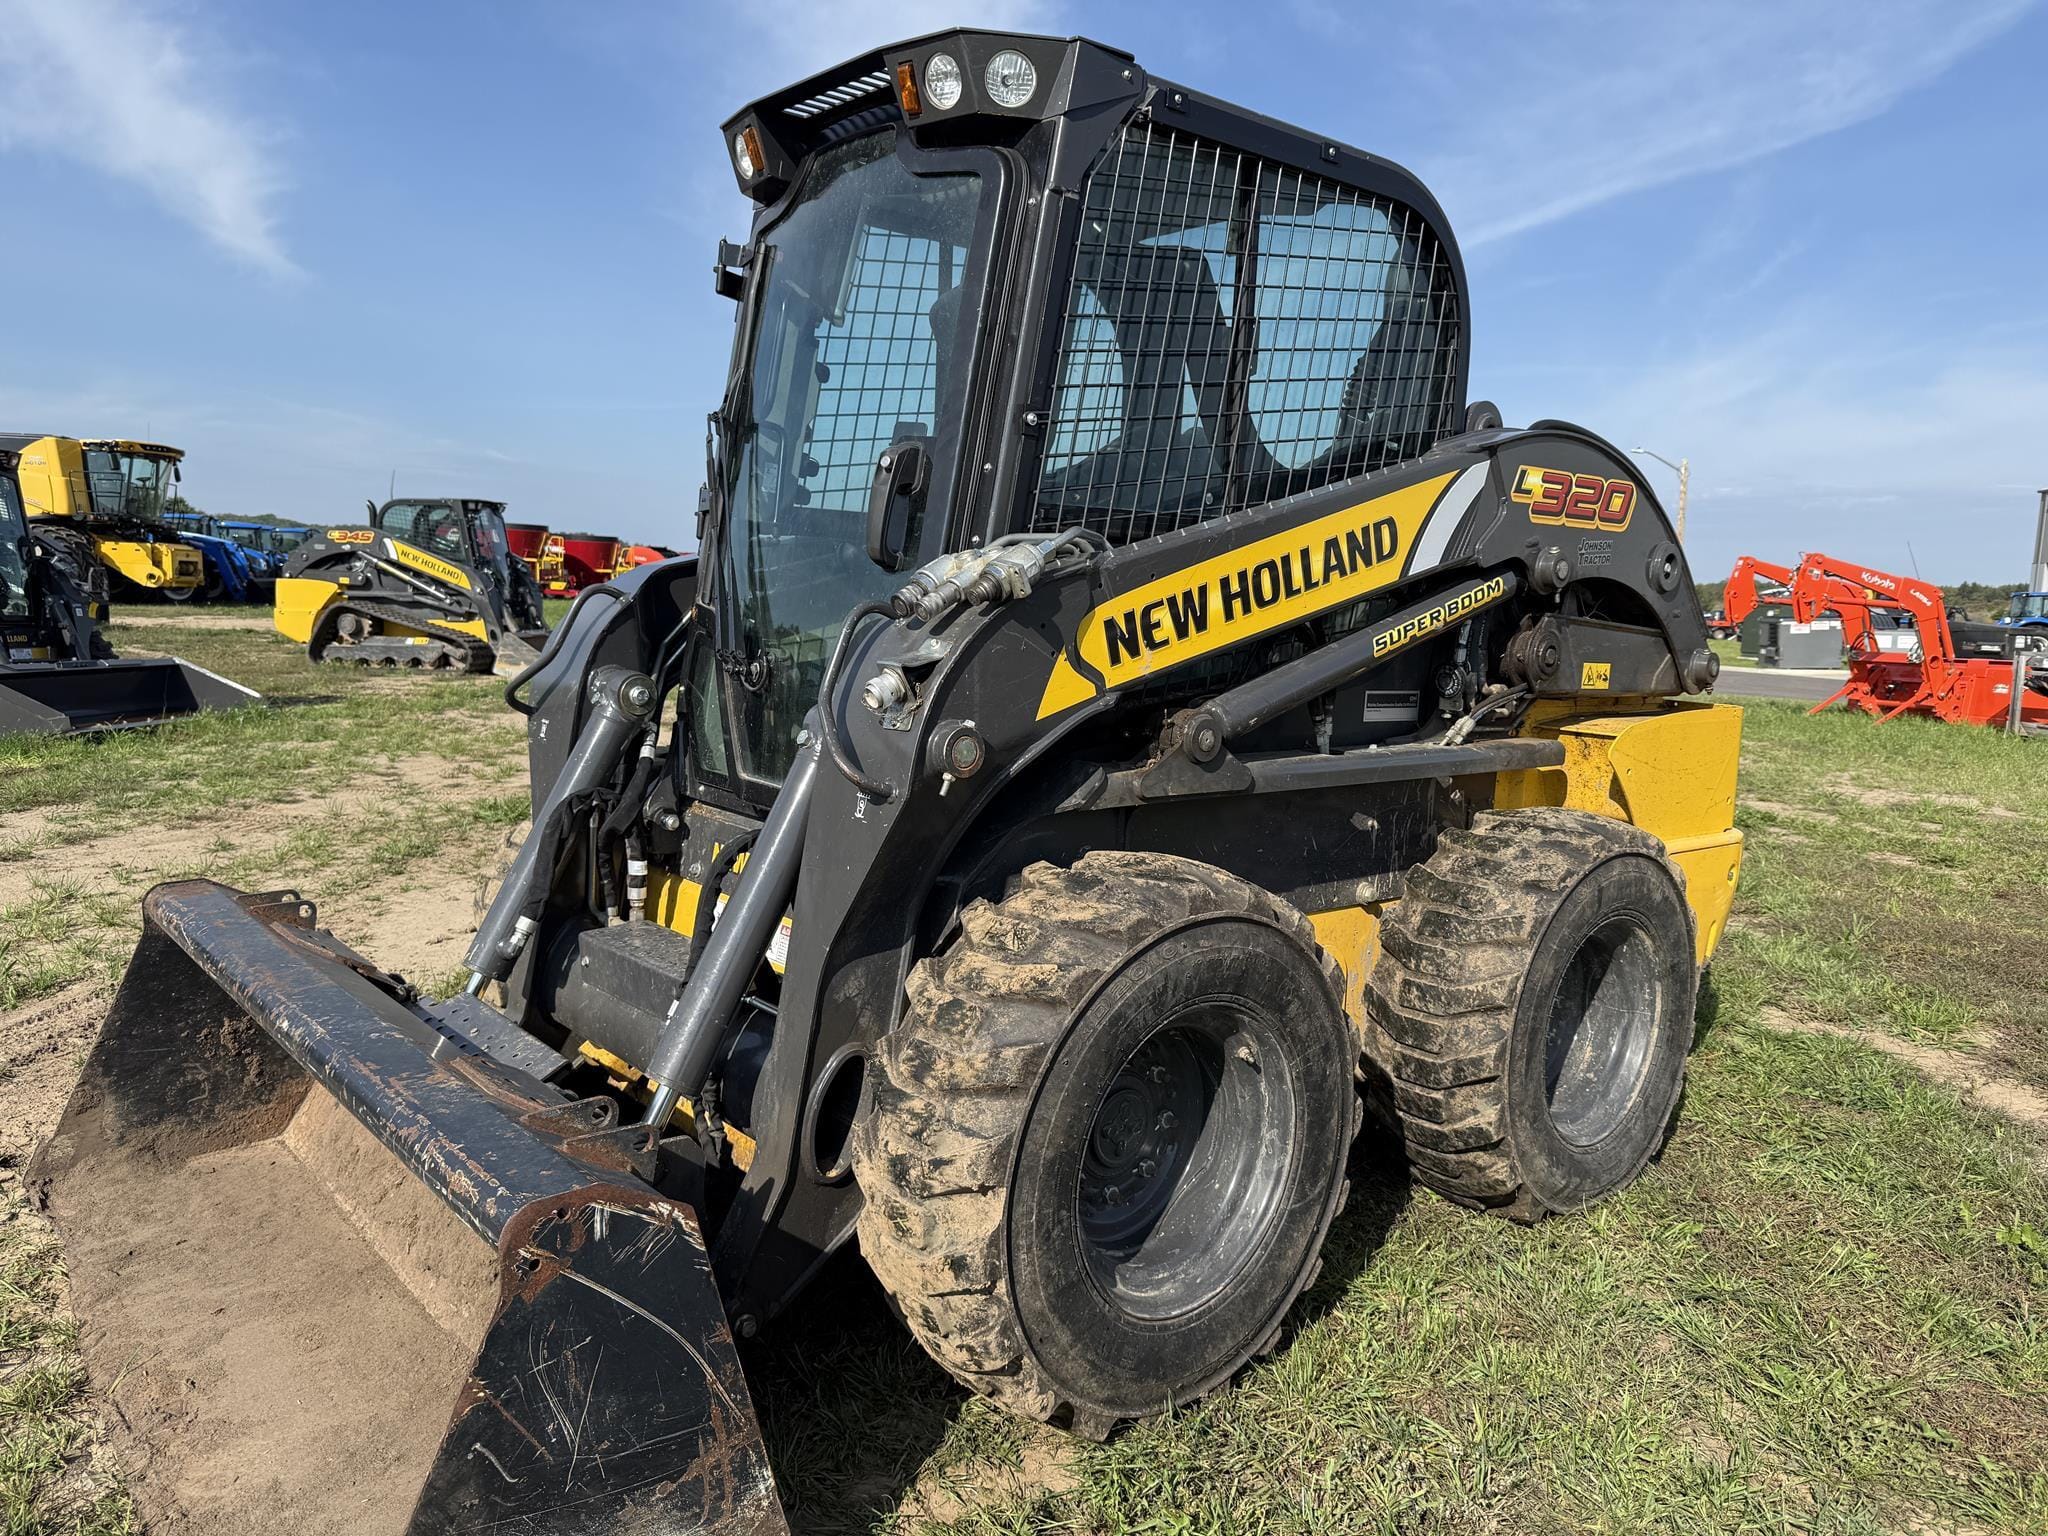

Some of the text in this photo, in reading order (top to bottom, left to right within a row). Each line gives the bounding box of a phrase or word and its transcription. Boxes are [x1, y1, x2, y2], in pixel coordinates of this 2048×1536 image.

[1511, 466, 1636, 531] L320
[327, 530, 374, 543] C345
[1578, 538, 1613, 551] JOHNSON
[400, 549, 460, 580] NEW HOLLAND
[1578, 553, 1612, 565] TRACTOR
[1861, 572, 1895, 589] Kubota
[1103, 515, 1398, 668] NEW HOLLAND
[1373, 577, 1503, 657] SUPER BOOM
[6, 634, 28, 642] LLAND
